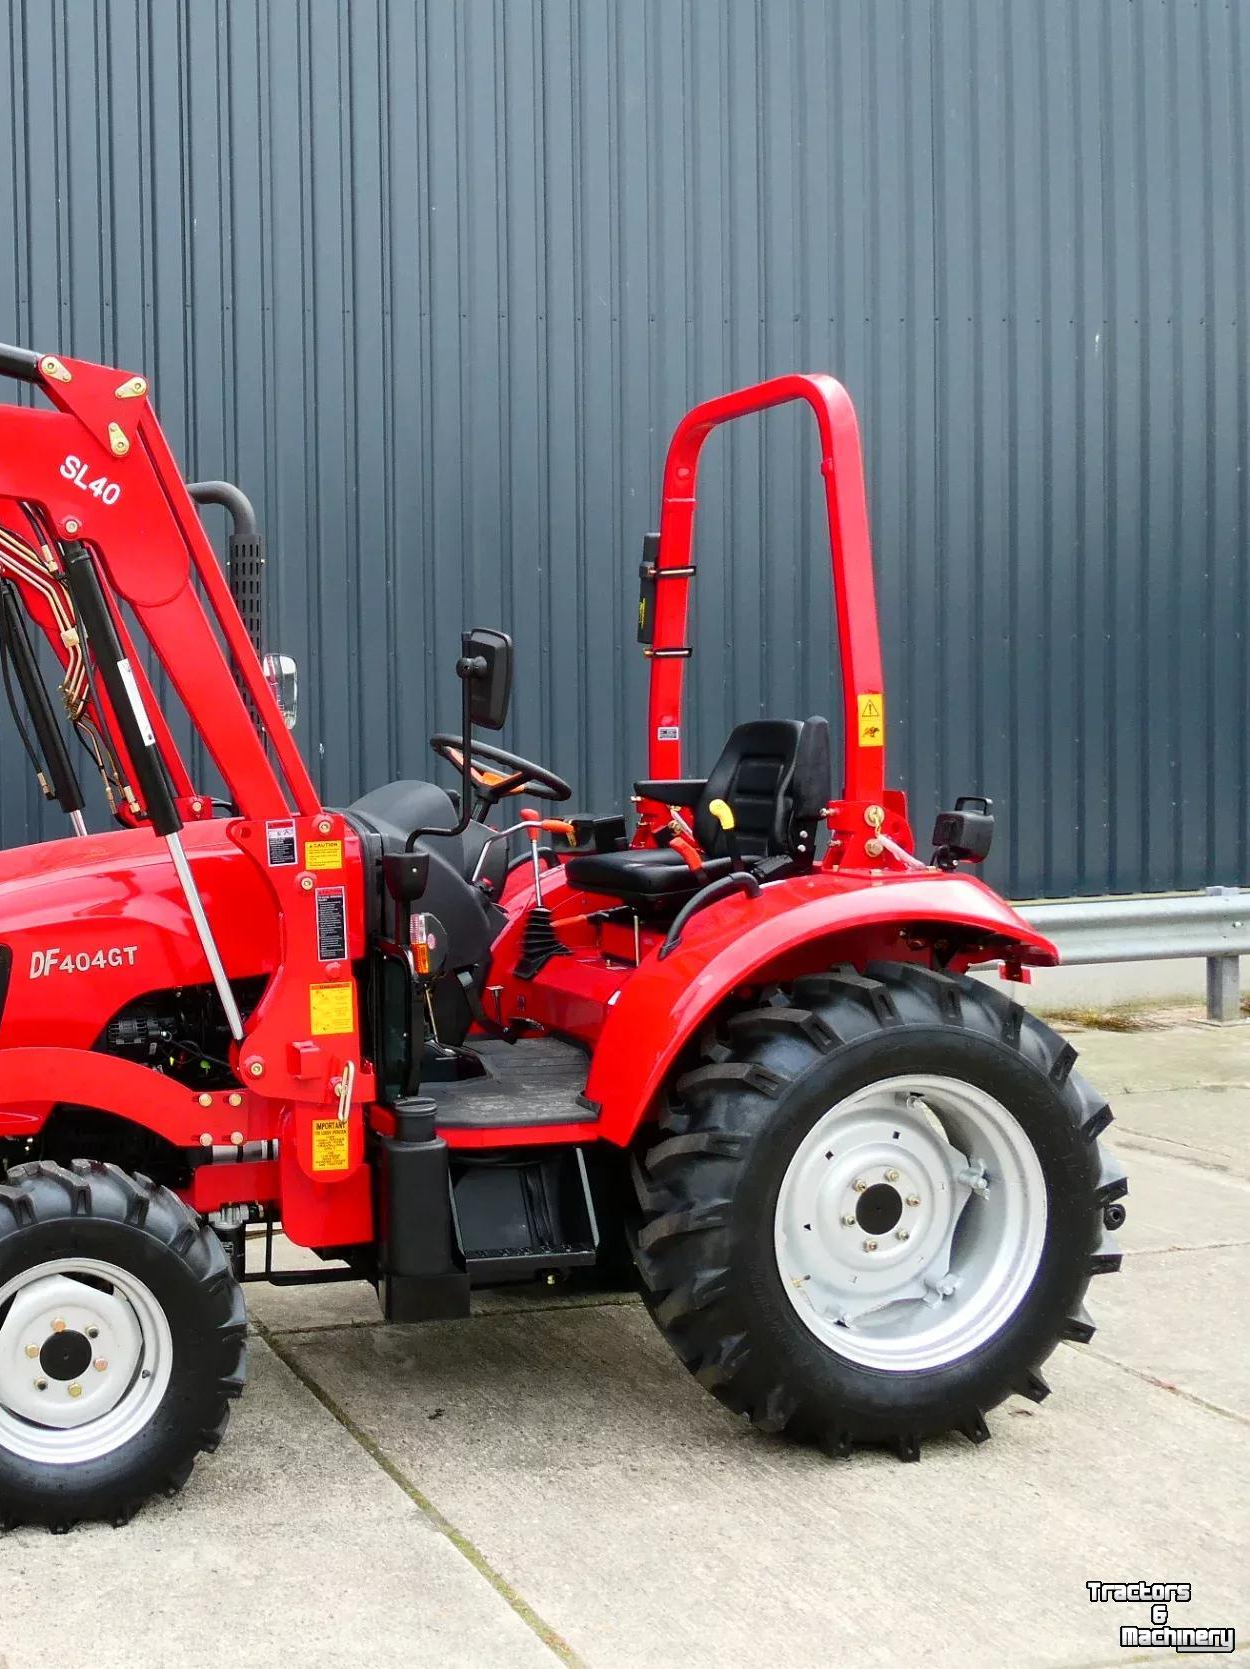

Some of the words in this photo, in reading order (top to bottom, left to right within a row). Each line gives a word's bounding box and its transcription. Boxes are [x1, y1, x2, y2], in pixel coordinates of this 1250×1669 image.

[59, 454, 121, 505] SL40
[29, 945, 138, 979] DF404GT
[316, 1121, 347, 1130] IMPORTANT
